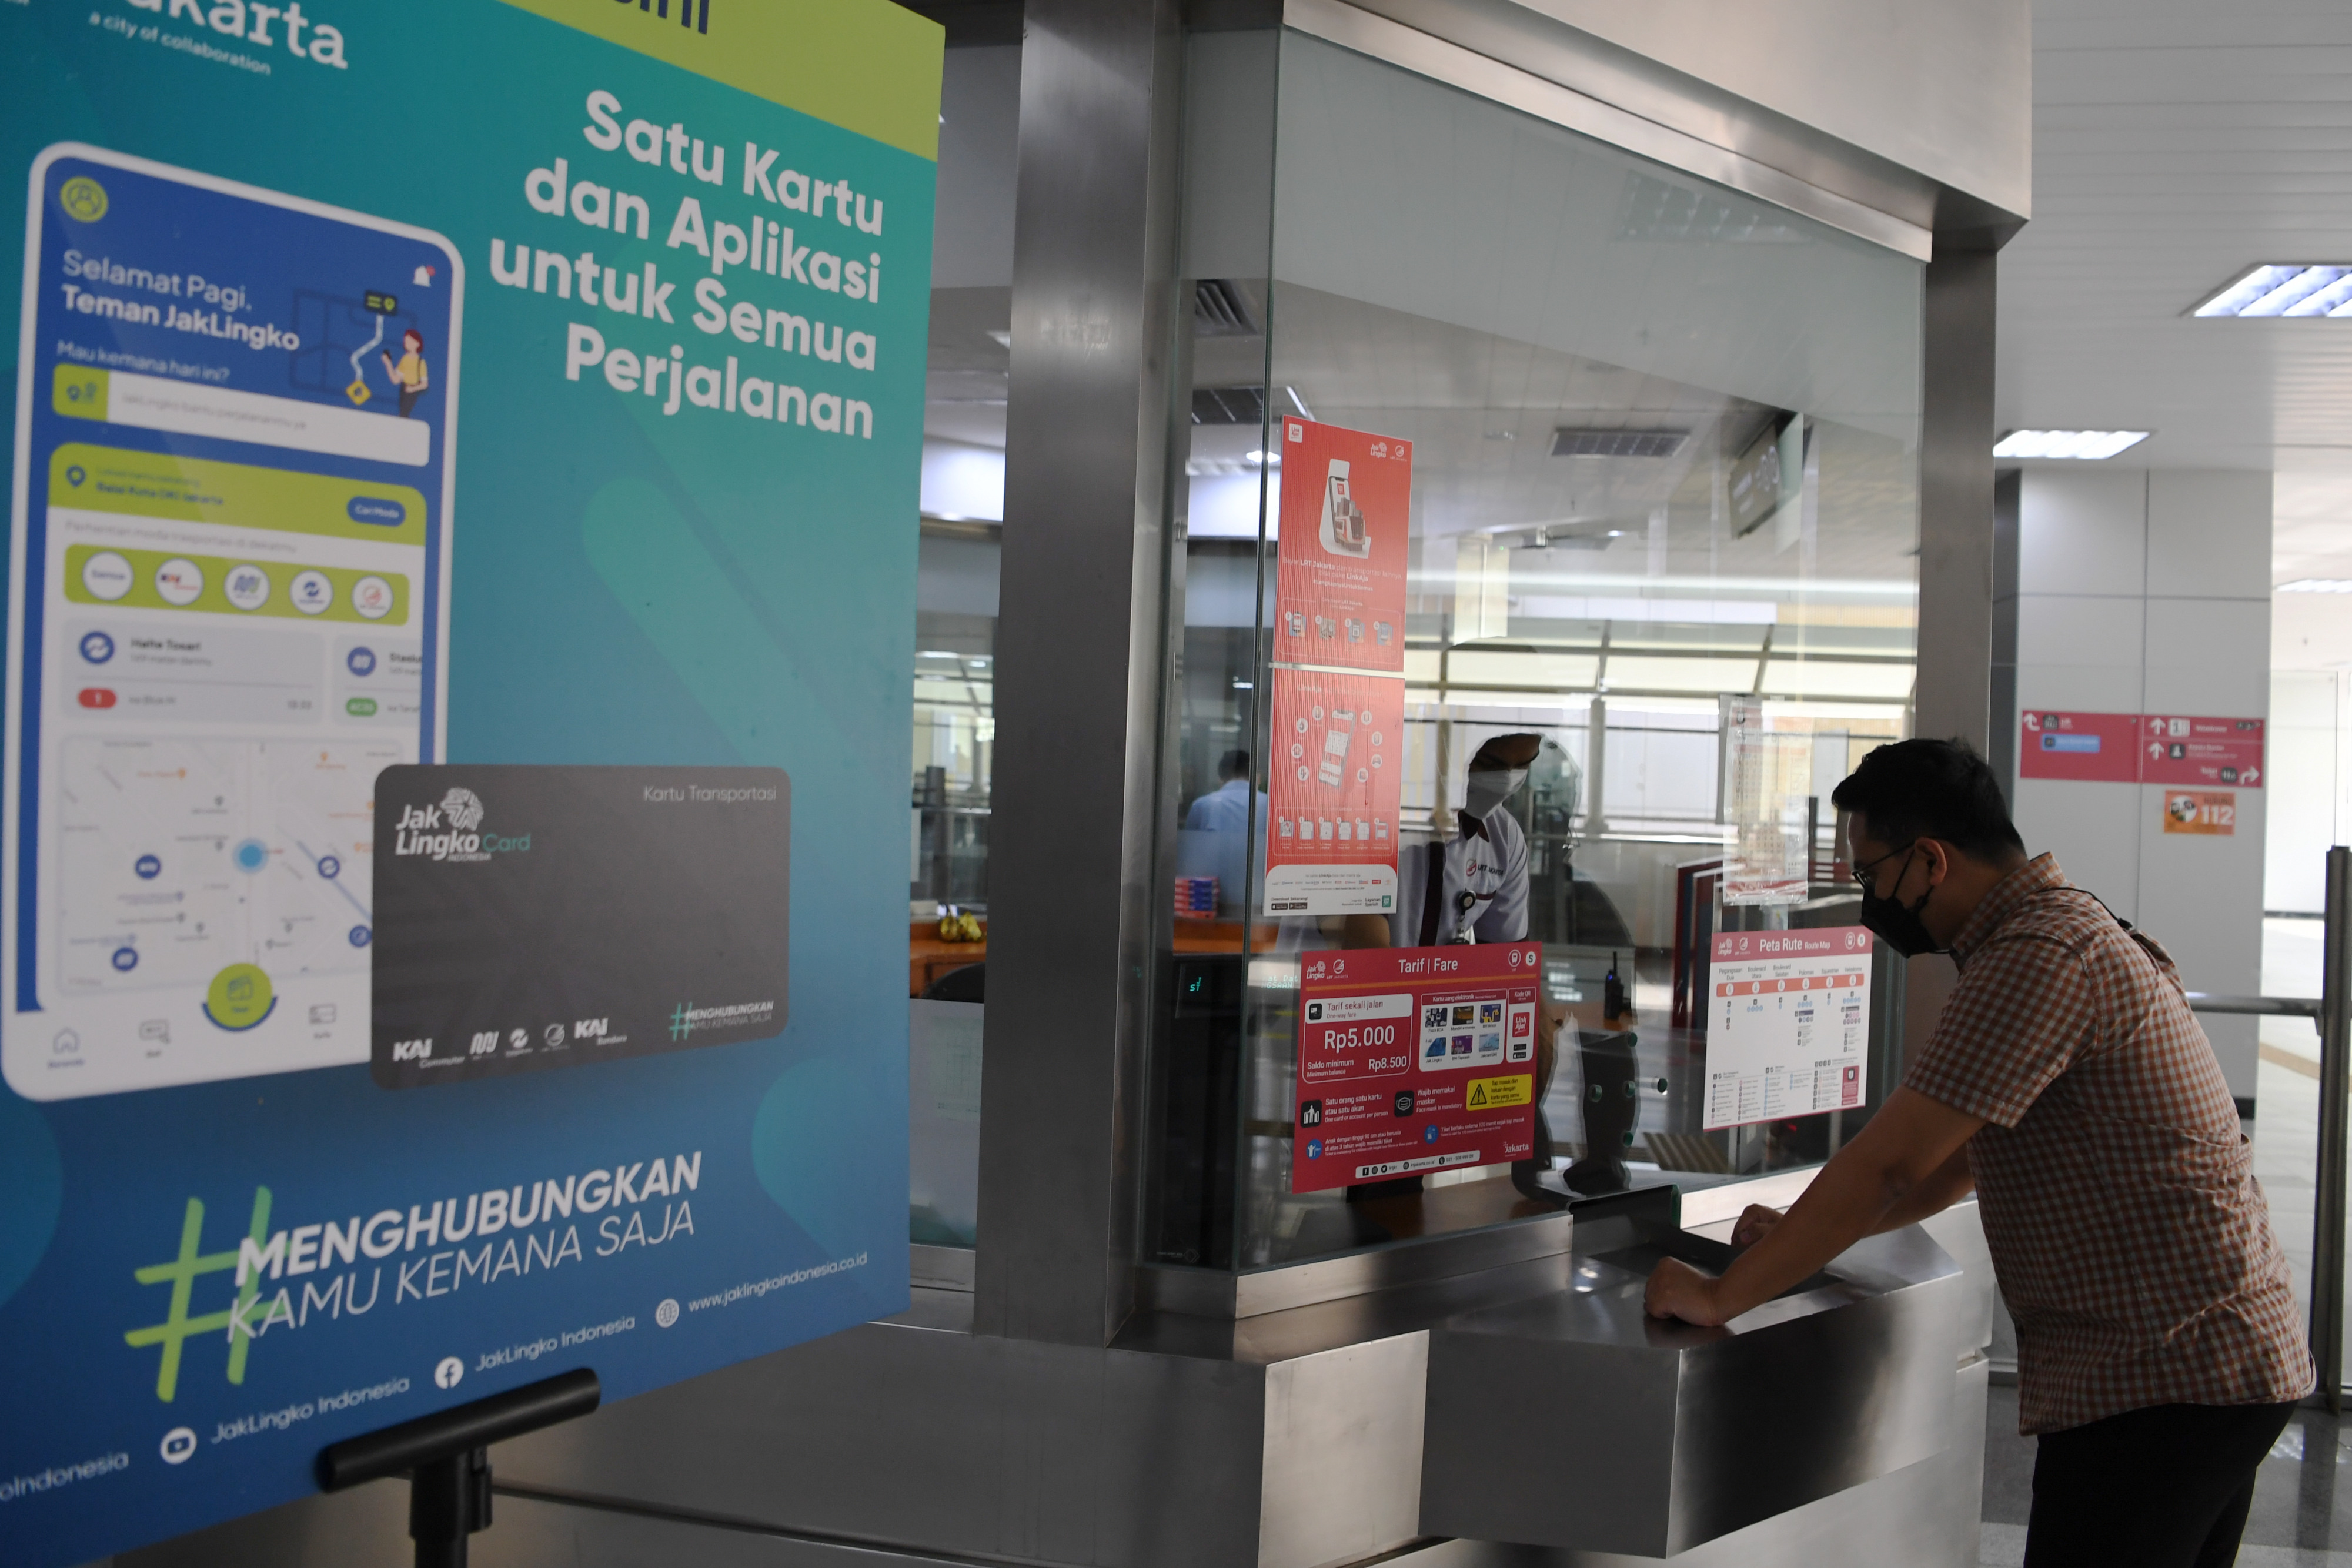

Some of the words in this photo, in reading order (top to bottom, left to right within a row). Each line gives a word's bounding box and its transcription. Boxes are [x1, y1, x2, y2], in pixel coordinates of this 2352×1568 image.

[89, 11, 100, 25] a
[103, 14, 137, 39] city
[139, 22, 159, 42] of
[161, 32, 272, 76] collaboration
[583, 89, 724, 186] Satu
[743, 141, 883, 236] Kartu
[524, 157, 650, 240] dan
[666, 196, 880, 304] Aplikasi
[62, 249, 183, 296] Selamat
[490, 238, 676, 325] untuk
[692, 277, 876, 372] Semua
[61, 285, 159, 326] Teman
[163, 302, 300, 352] JakLingko
[98, 346, 168, 375] kemana
[566, 322, 873, 440] Perjalanan
[1300, 559, 1312, 567] LRT
[1312, 560, 1335, 571] Jakarta
[1346, 573, 1368, 582] LinkAja
[643, 785, 684, 802] Kartu
[689, 785, 777, 805] Transportasi
[395, 804, 442, 830] Jak
[2201, 805, 2234, 825] 112
[395, 828, 480, 861] Lingko
[482, 833, 530, 852] Card
[1759, 939, 1780, 952] Peta
[1782, 938, 1803, 951] Rute
[1820, 941, 1831, 951] Map
[1306, 971, 1325, 981] Lingko
[1398, 958, 1425, 974] Tarif
[1434, 958, 1458, 972] Fare
[685, 1001, 774, 1021] MENGHUBUNGKAN
[1327, 1002, 1344, 1011] Tarif
[1345, 1001, 1365, 1010] sekali
[1366, 1000, 1383, 1010] jalan
[1515, 1022, 1526, 1031] Aja!
[1324, 1025, 1395, 1054] Rp5.000
[1307, 1061, 1325, 1070] Saldo
[1325, 1059, 1354, 1068] minimum
[1368, 1055, 1407, 1073] Rp8.500
[1325, 1098, 1338, 1106] Satu
[1339, 1096, 1355, 1105] orang
[1355, 1095, 1367, 1103] satu
[1368, 1093, 1382, 1101] kartu
[1416, 1098, 1436, 1106] masker
[1417, 1088, 1432, 1096] Wajib
[1337, 1135, 1352, 1144] dengan
[1504, 1143, 1529, 1154] Jakarta
[235, 1151, 703, 1288] MENGHUBUNGKAN
[228, 1267, 382, 1345] KAMU
[395, 1225, 583, 1305] KEMANA
[596, 1199, 696, 1258] SAJA
[475, 1336, 558, 1372] JakLingko
[562, 1315, 636, 1349] Indonesia
[688, 1251, 868, 1312] www.jaklingkoindonesia.co.id
[210, 1398, 314, 1445] JakLingko
[318, 1376, 410, 1415] Indonesia
